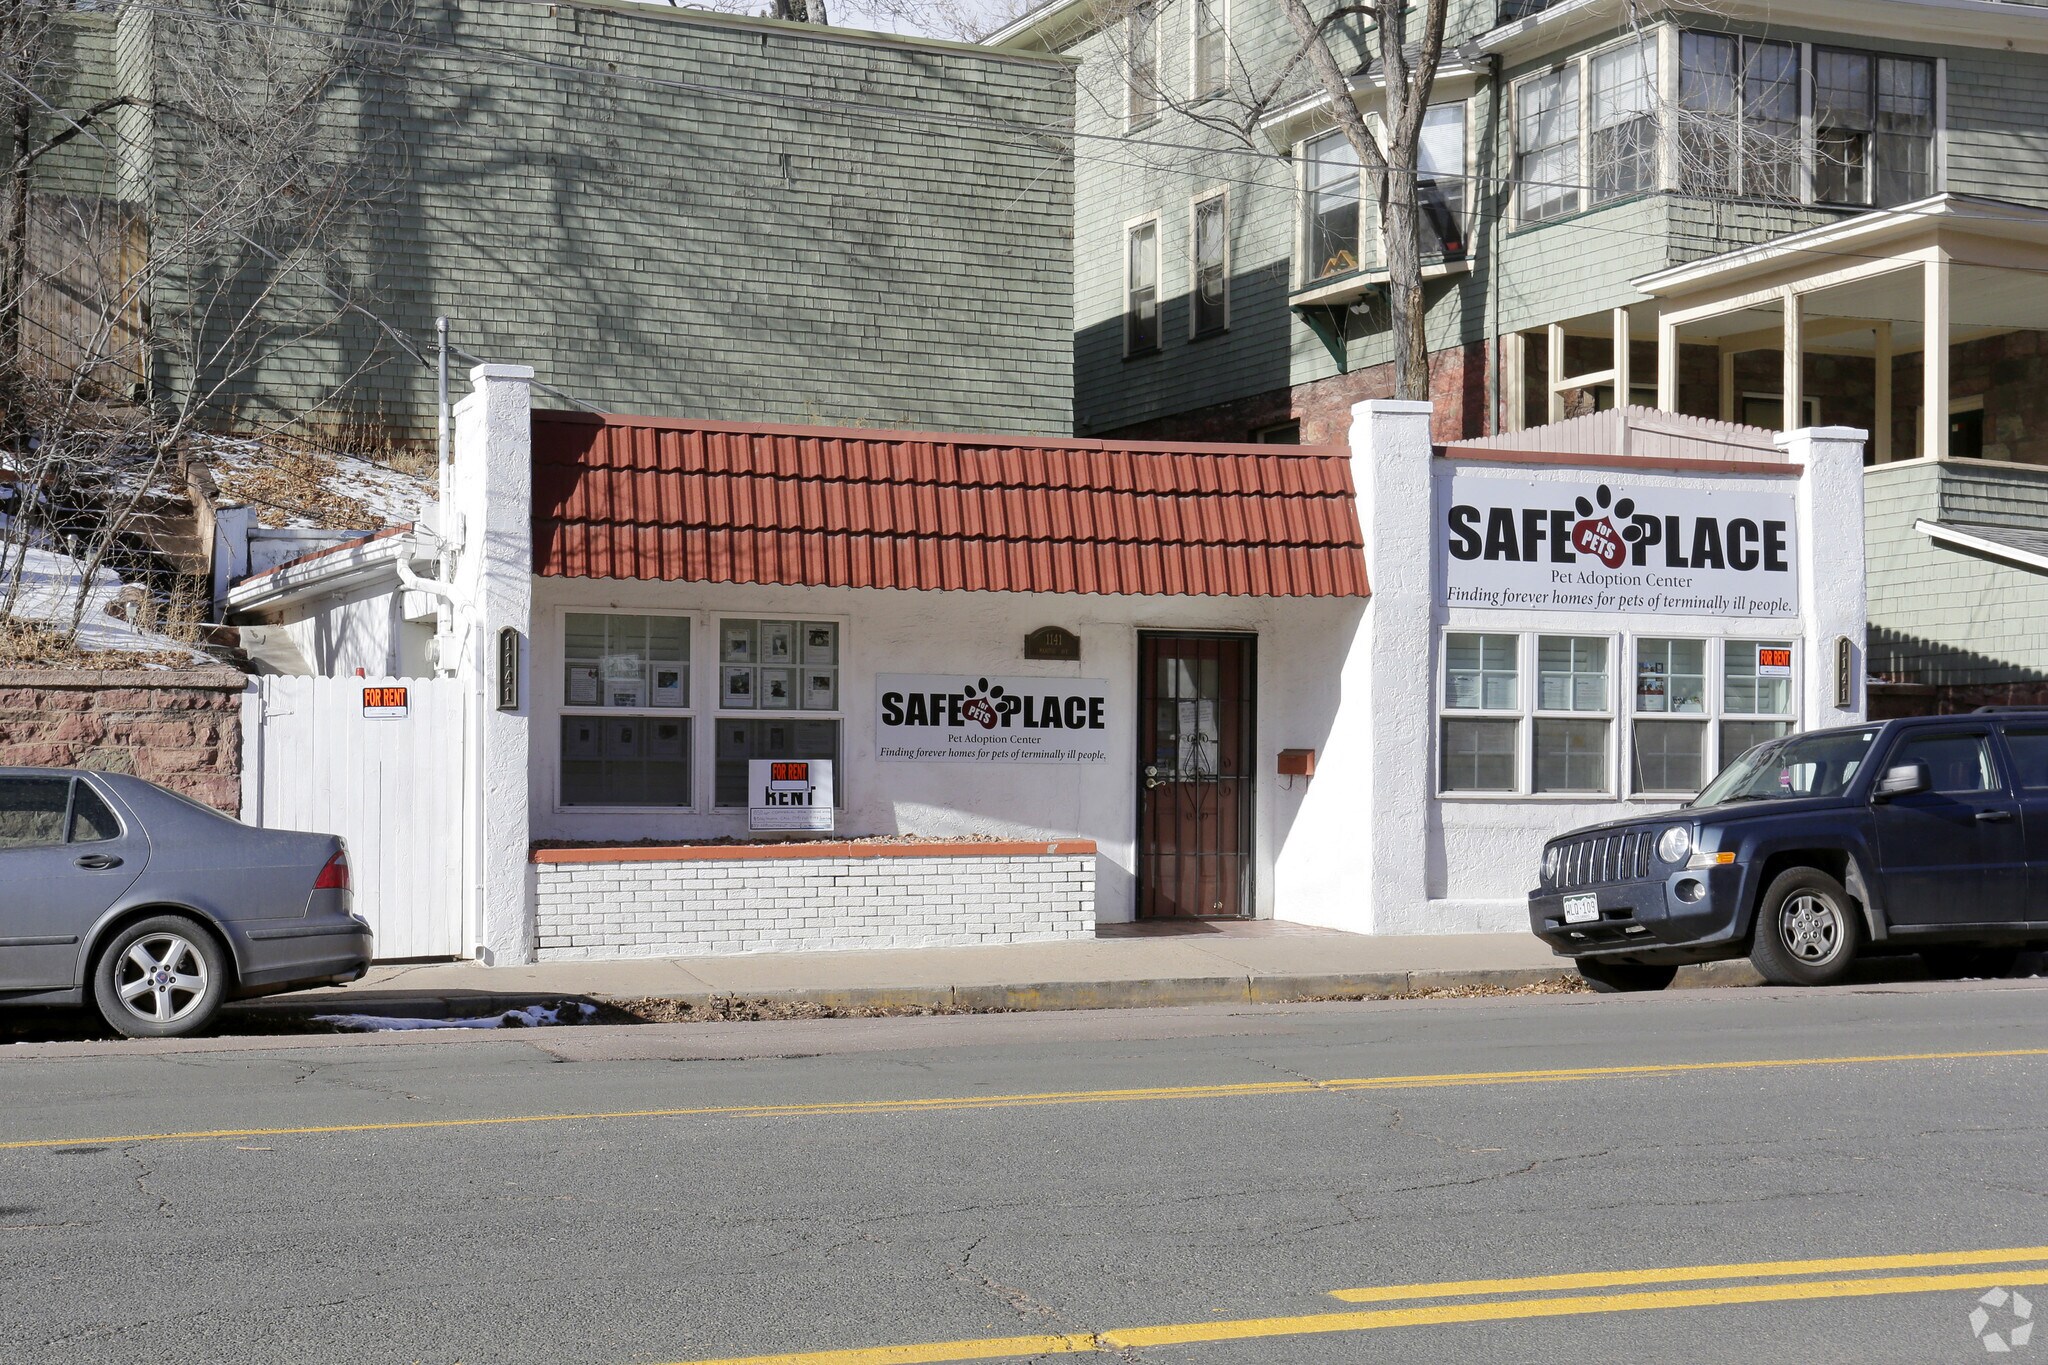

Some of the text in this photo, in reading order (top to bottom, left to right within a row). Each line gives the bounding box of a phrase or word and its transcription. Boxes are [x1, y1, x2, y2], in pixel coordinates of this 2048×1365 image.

[1448, 504, 1788, 572] SAFE PLACE
[1596, 521, 1612, 538] for
[1581, 529, 1616, 560] PETS
[1551, 569, 1693, 588] Pet Adoption Center
[1447, 586, 1792, 614] Finding forever homes for pets of terminally ill people.
[1046, 633, 1062, 646] 1141
[1760, 650, 1790, 666] FOR RENT
[504, 636, 512, 701] 1141
[364, 688, 406, 707] FOR RENT
[977, 700, 988, 710] for
[881, 691, 1105, 730] SAFE PLACE
[968, 705, 991, 724] PETS
[948, 734, 1041, 745] Pet Adoption Center
[880, 747, 1106, 761] Finding forever homes for pets of terminally ill people.
[772, 763, 807, 780] FOR RENT
